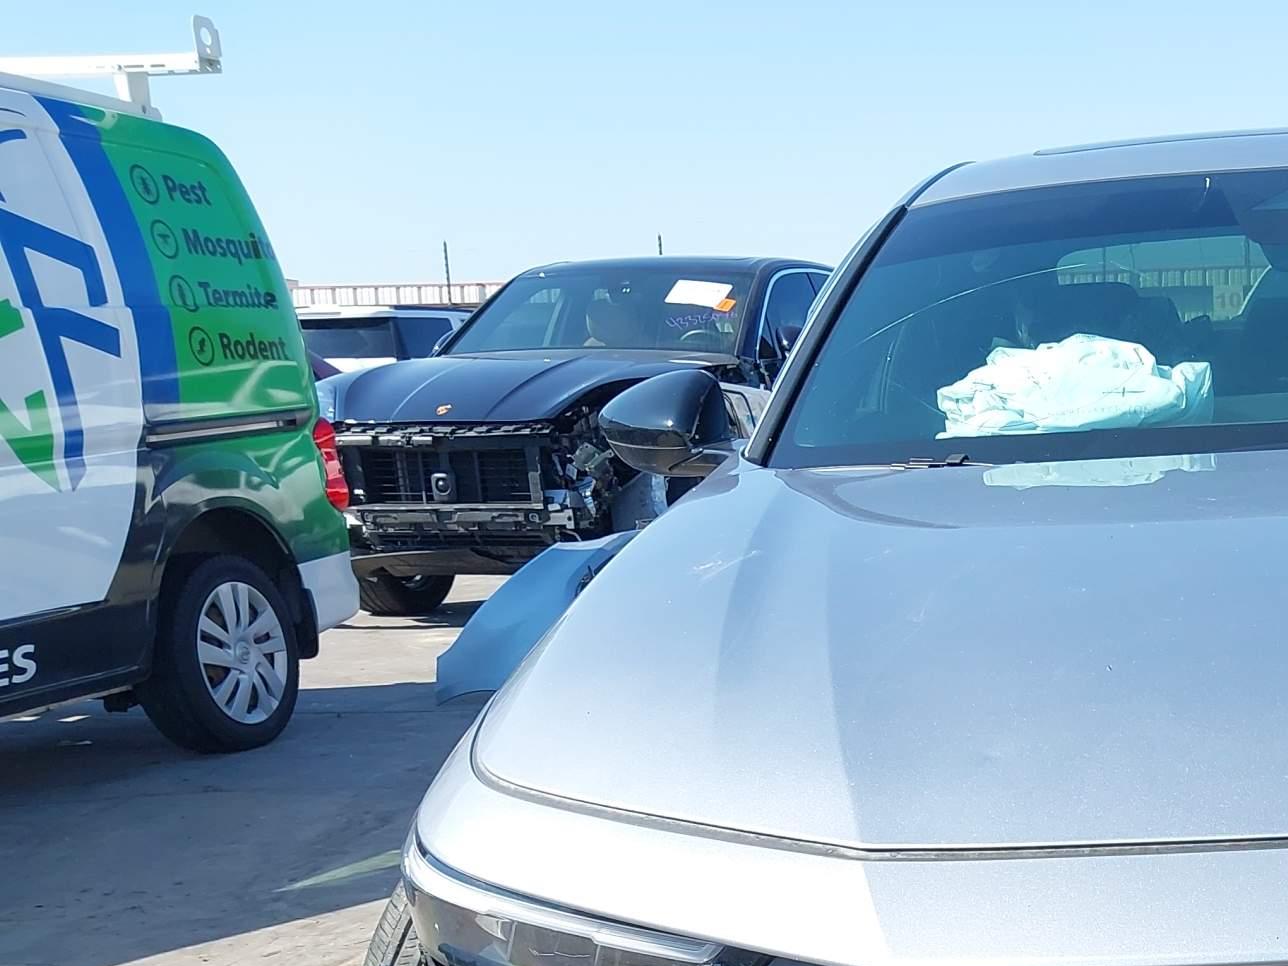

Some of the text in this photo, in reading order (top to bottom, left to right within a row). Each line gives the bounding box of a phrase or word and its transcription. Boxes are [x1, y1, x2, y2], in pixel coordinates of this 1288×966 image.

[161, 174, 212, 207] Pest
[197, 281, 279, 310] Termite
[218, 332, 291, 362] Rodent
